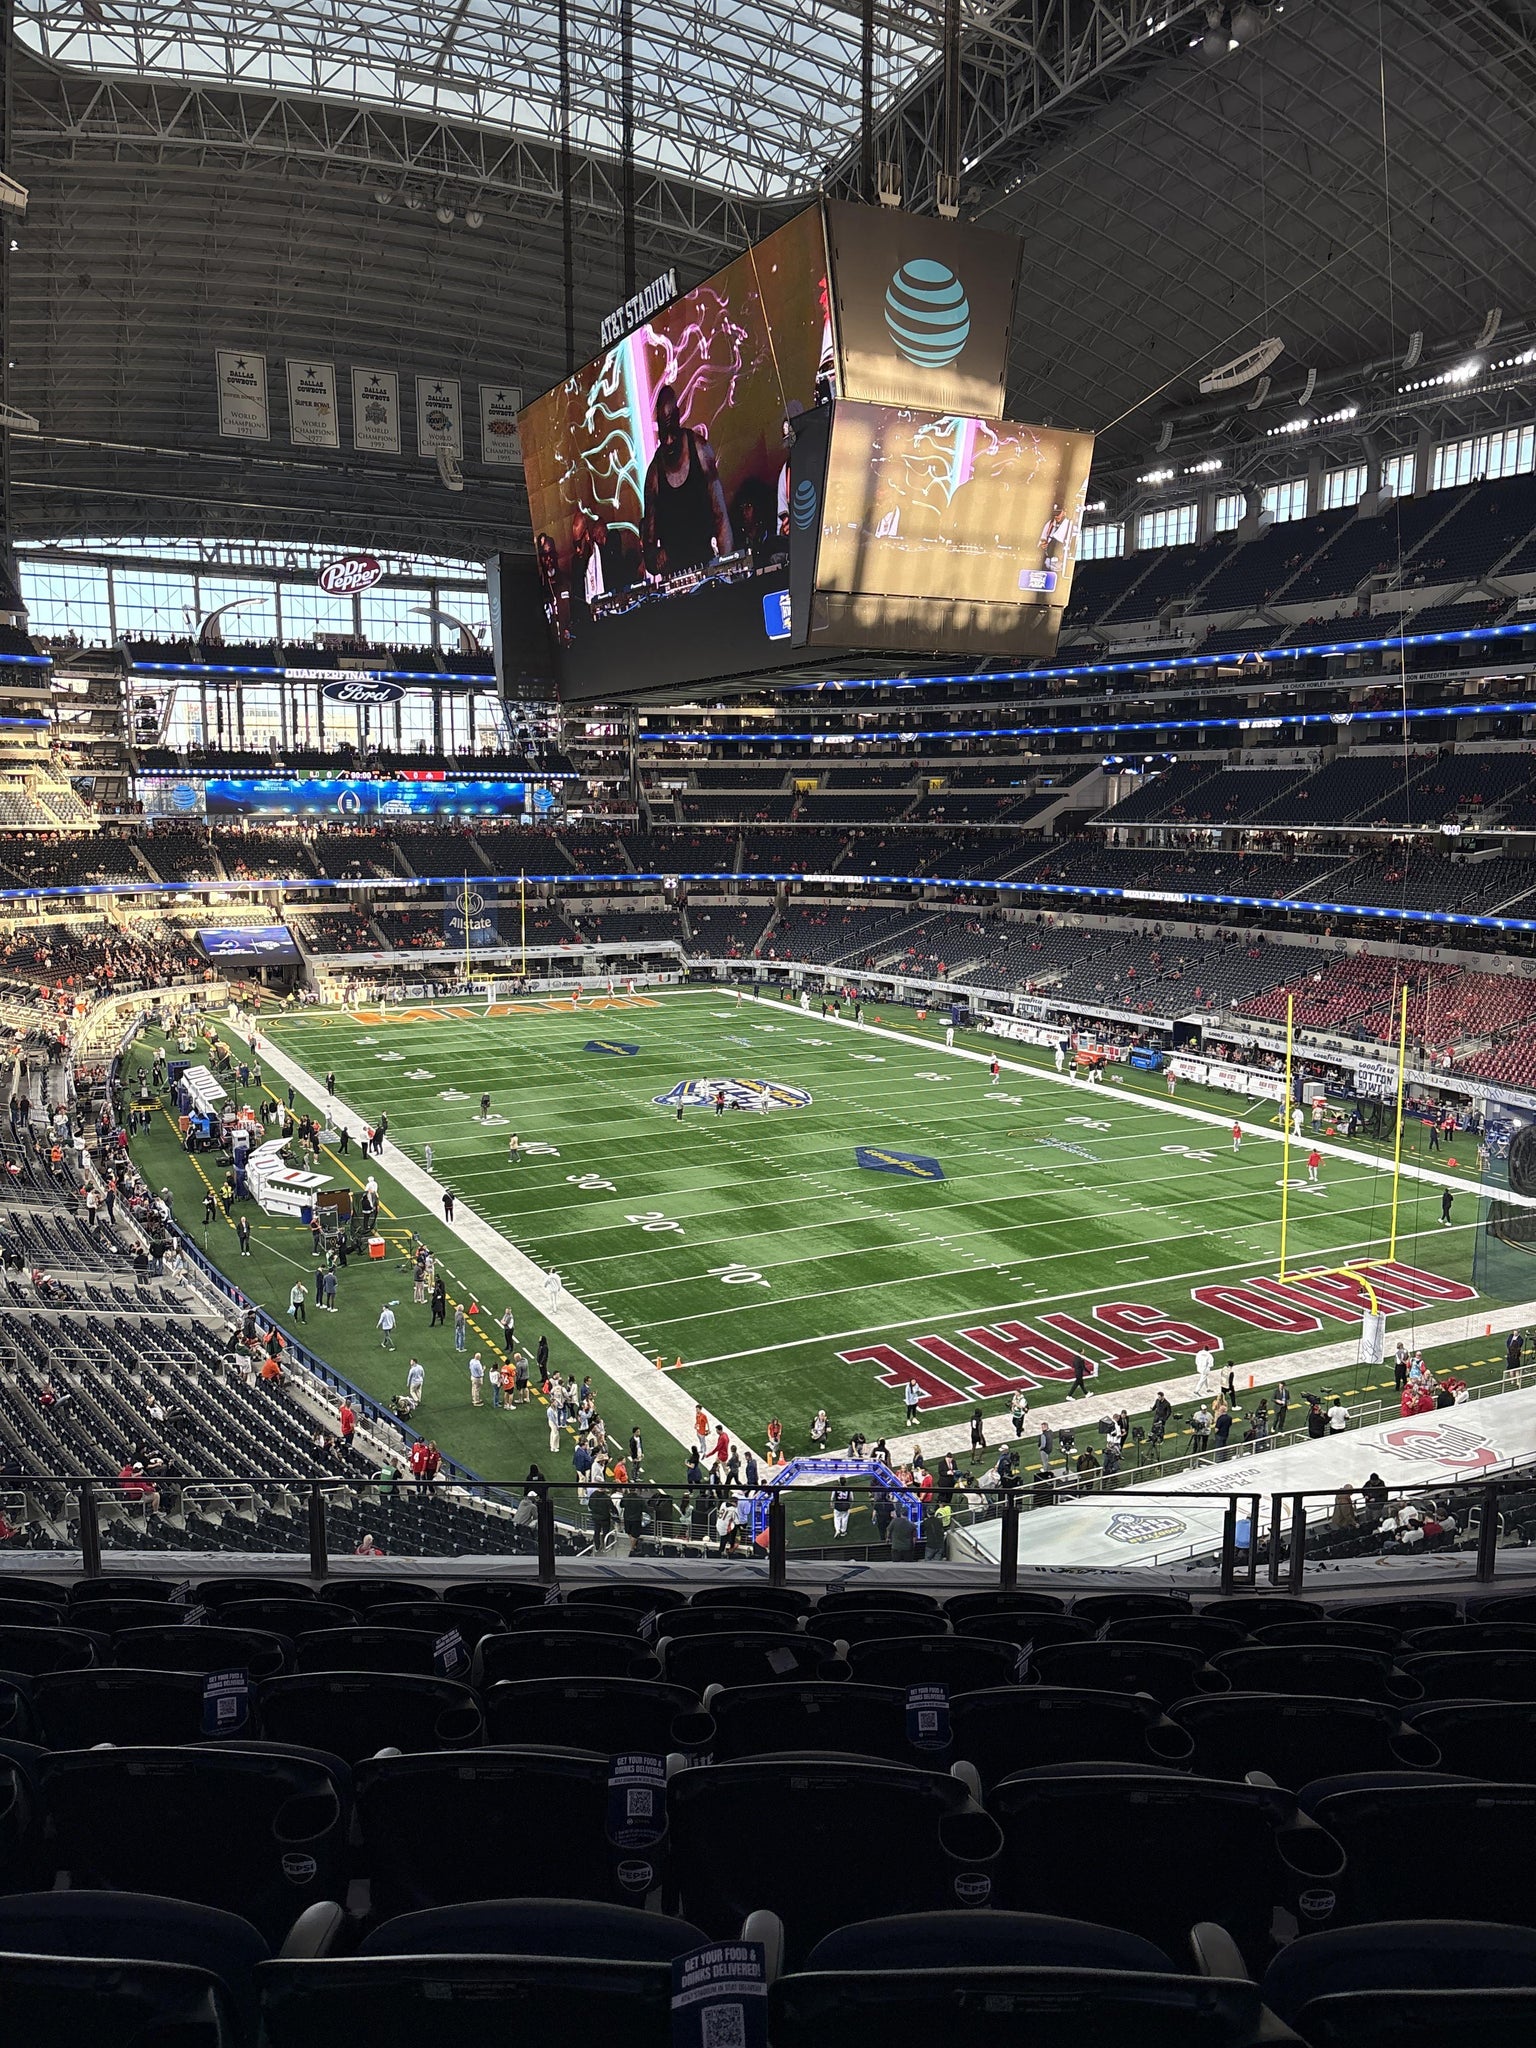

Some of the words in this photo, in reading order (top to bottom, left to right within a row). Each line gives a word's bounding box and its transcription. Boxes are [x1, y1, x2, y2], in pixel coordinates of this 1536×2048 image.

[601, 306, 625, 348] AT&T
[625, 267, 678, 329] STADIUM
[229, 370, 254, 379] DALLAS
[227, 377, 257, 386] COWBOYS
[297, 386, 326, 395] COWBOYS
[364, 387, 387, 395] DALLAS
[361, 393, 390, 402] COWBOYS
[295, 399, 312, 407] SUPER
[313, 401, 331, 409] BOWL
[425, 401, 452, 409] COWBOYS
[490, 403, 512, 411] DALLAS
[230, 411, 257, 420] WORLD
[488, 409, 515, 417] COWBOYS
[223, 418, 265, 429] CHAMPIONS
[301, 420, 327, 428] WORLD
[295, 426, 335, 436] CHAMPIONS
[365, 426, 389, 434] WORLD
[357, 433, 397, 443] CHAMPIONS
[428, 433, 452, 441] WORLD
[491, 440, 514, 448] WORLD
[345, 560, 367, 577] Dr
[326, 563, 380, 591] Pepper
[285, 668, 374, 681] QUARTERFINAL
[1406, 673, 1418, 681] DON
[1419, 672, 1447, 680] MEREDITH
[337, 682, 392, 702] Ford
[351, 771, 372, 779] 90:00
[664, 877, 677, 889] 25
[449, 916, 492, 930] Allstate
[346, 996, 664, 1025] MIAMI
[1018, 1003, 1042, 1013] COTTON
[1208, 1031, 1234, 1040] GOODYEAR
[1313, 1052, 1343, 1062] GOODYEAR
[1358, 1061, 1395, 1075] GOODYEAR
[1358, 1070, 1394, 1086] COTTON
[1065, 1116, 1112, 1132] 30
[518, 1141, 558, 1155] 40
[1160, 1145, 1218, 1163] 20
[864, 1149, 934, 1177] GOODYEAR
[565, 1172, 614, 1191] 30
[624, 1211, 680, 1232] 20
[707, 1262, 763, 1284] 10
[1190, 1257, 1481, 1335] OHIO
[833, 1301, 1225, 1413] STATE
[1128, 1524, 1187, 1544] GOODYEAR
[616, 1756, 628, 1766] GET
[628, 1755, 643, 1765] YOUR
[643, 1756, 658, 1766] FOOD
[614, 1765, 635, 1775] DRINKS
[635, 1764, 665, 1777] DELIVERED!
[284, 1859, 315, 1873] PEPSI
[619, 1868, 651, 1881] PEPSI
[957, 1882, 990, 1894] PEPSI
[1303, 1896, 1335, 1909] PEPSI
[684, 1958, 700, 1973] GET
[700, 1950, 724, 1966] YOUR
[724, 1947, 748, 1961] FOOD
[749, 1949, 757, 1960] &
[681, 1966, 711, 1988] DRINKS
[712, 1962, 761, 1978] DELIVERED!
